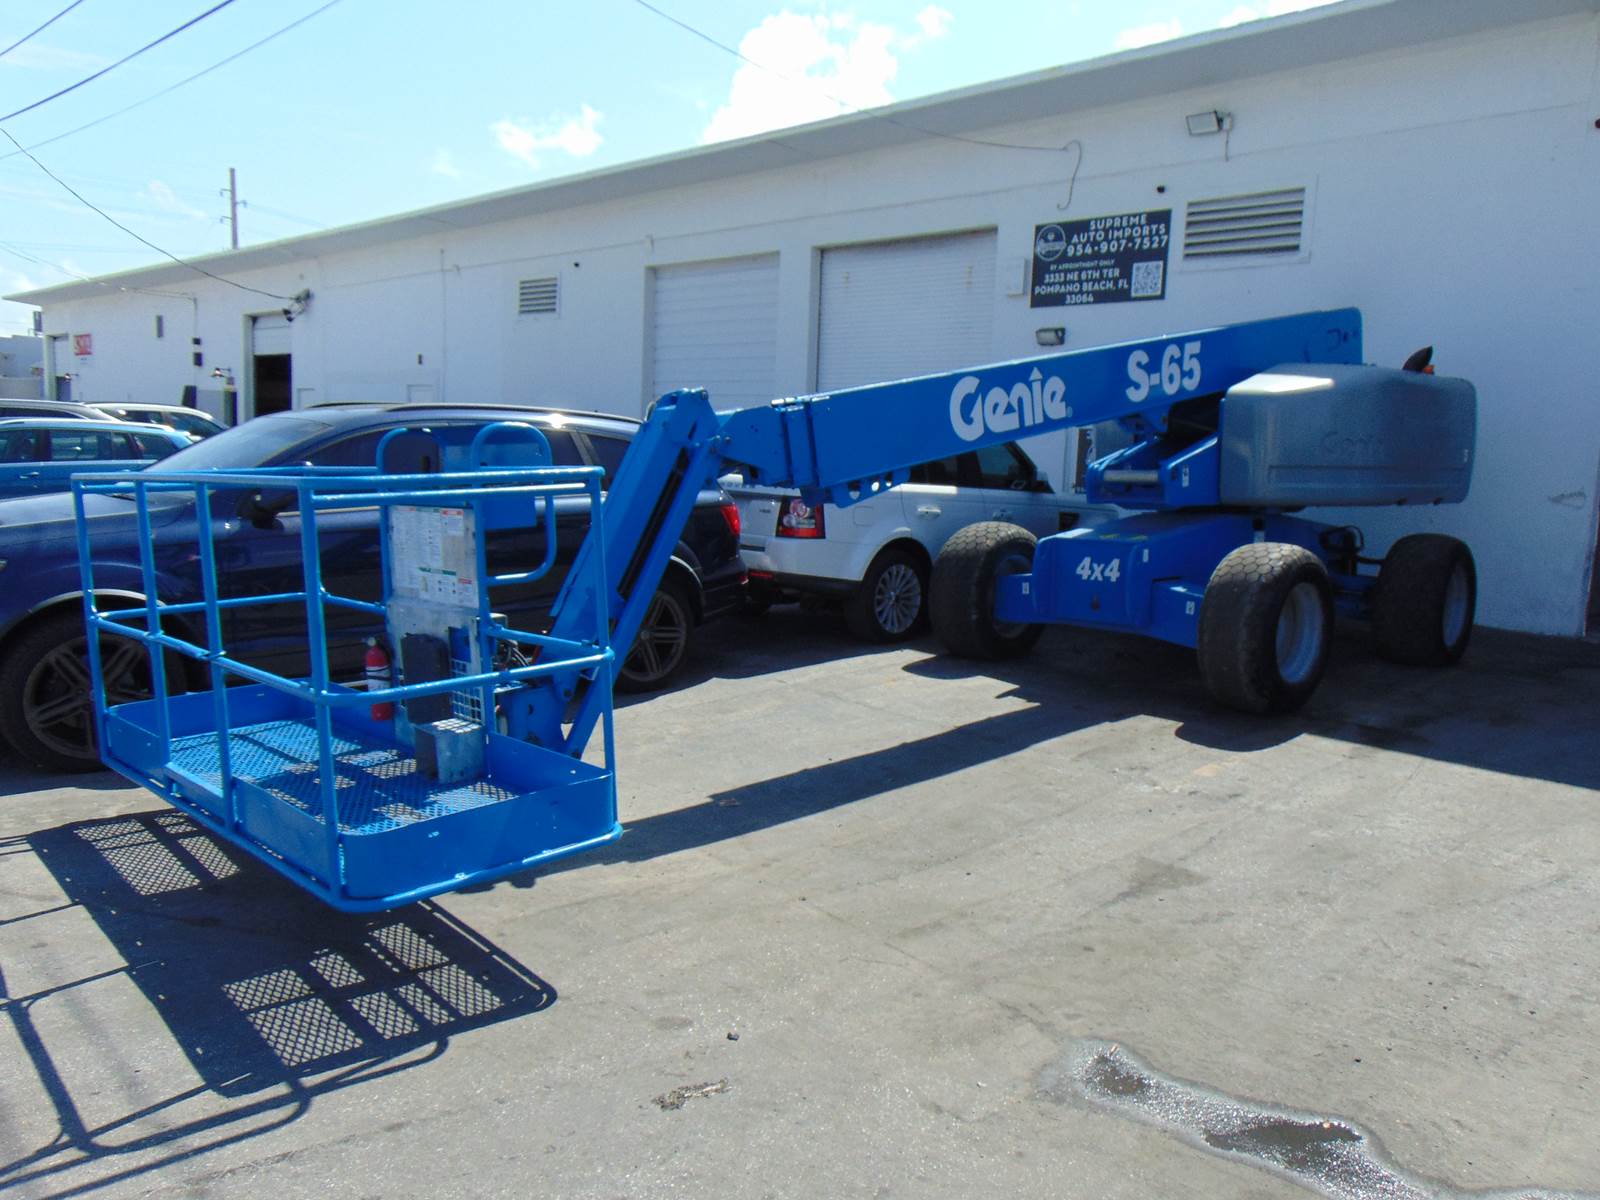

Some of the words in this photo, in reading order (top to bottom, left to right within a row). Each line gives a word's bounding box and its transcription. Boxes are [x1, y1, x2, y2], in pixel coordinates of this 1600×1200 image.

[1089, 214, 1147, 230] SUPREME
[1071, 231, 1105, 244] AUTO
[1108, 224, 1166, 239] IMPORTS
[1044, 273, 1065, 283] 3333
[1066, 271, 1079, 281] NE
[1081, 269, 1100, 280] 6TH
[1102, 268, 1120, 278] TER
[1034, 283, 1080, 296] POMPANO
[1118, 278, 1129, 289] FL
[1065, 293, 1094, 304] 33064
[1125, 340, 1201, 402] S-65
[950, 367, 1068, 442] Genie
[1076, 556, 1120, 582] 4x4
